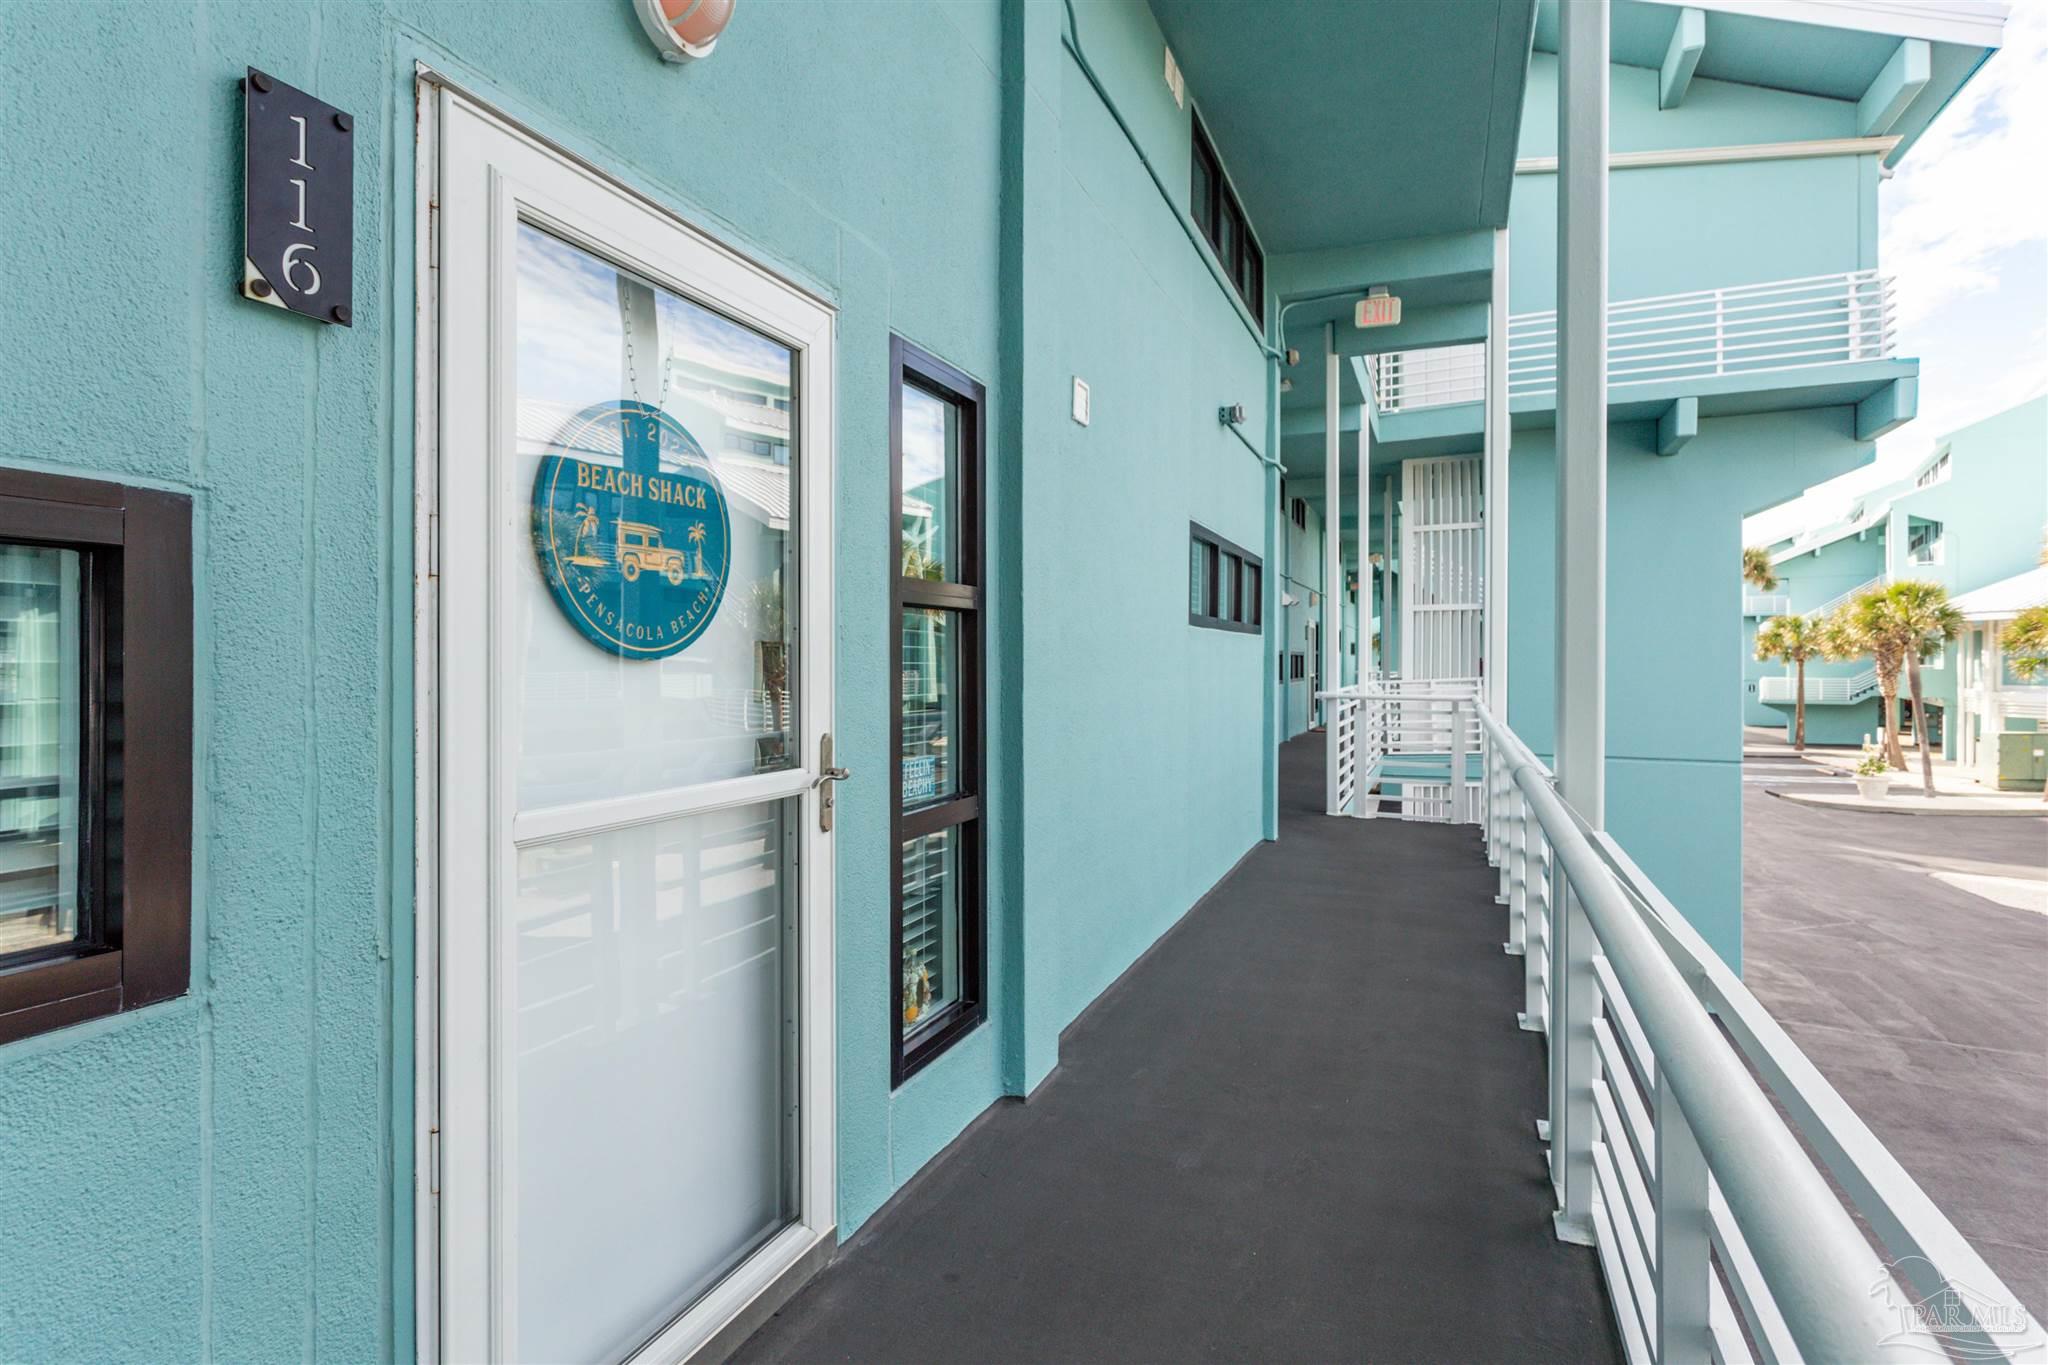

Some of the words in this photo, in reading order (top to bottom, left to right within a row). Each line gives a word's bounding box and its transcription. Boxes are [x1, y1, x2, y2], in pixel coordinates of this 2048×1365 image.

[281, 114, 321, 296] 116
[1362, 300, 1393, 324] EXIT
[576, 462, 644, 498] BEACH
[648, 477, 707, 510] SHACK
[579, 576, 664, 641] PENSACOLA
[670, 590, 708, 634] BEACH
